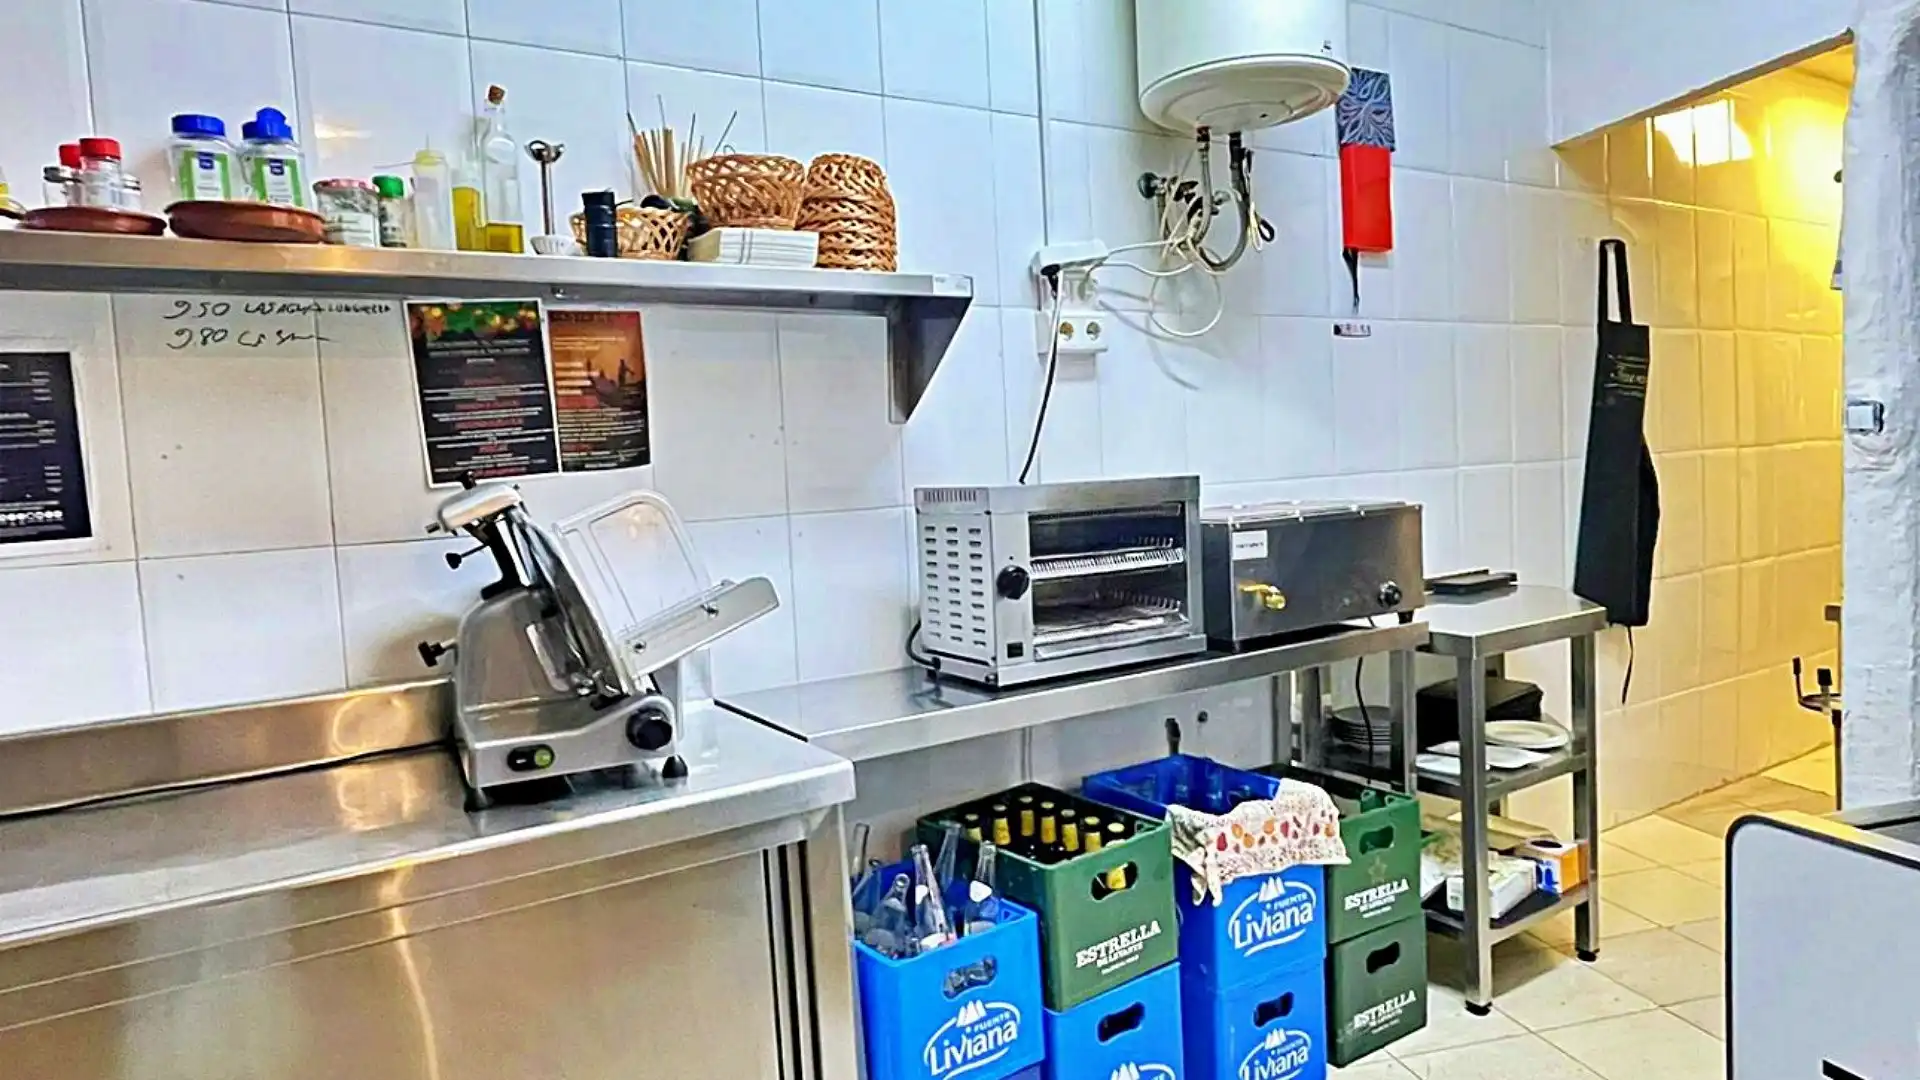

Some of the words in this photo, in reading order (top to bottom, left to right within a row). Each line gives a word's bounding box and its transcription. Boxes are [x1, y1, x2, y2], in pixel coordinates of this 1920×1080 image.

[1344, 878, 1410, 911] ESTRELLA
[1076, 920, 1162, 968] ESTRELLA
[1234, 902, 1314, 949] Liviana
[1353, 990, 1417, 1029] ESTRELLA
[930, 1020, 1018, 1076] Liviana
[1243, 1046, 1309, 1080] Liviana
